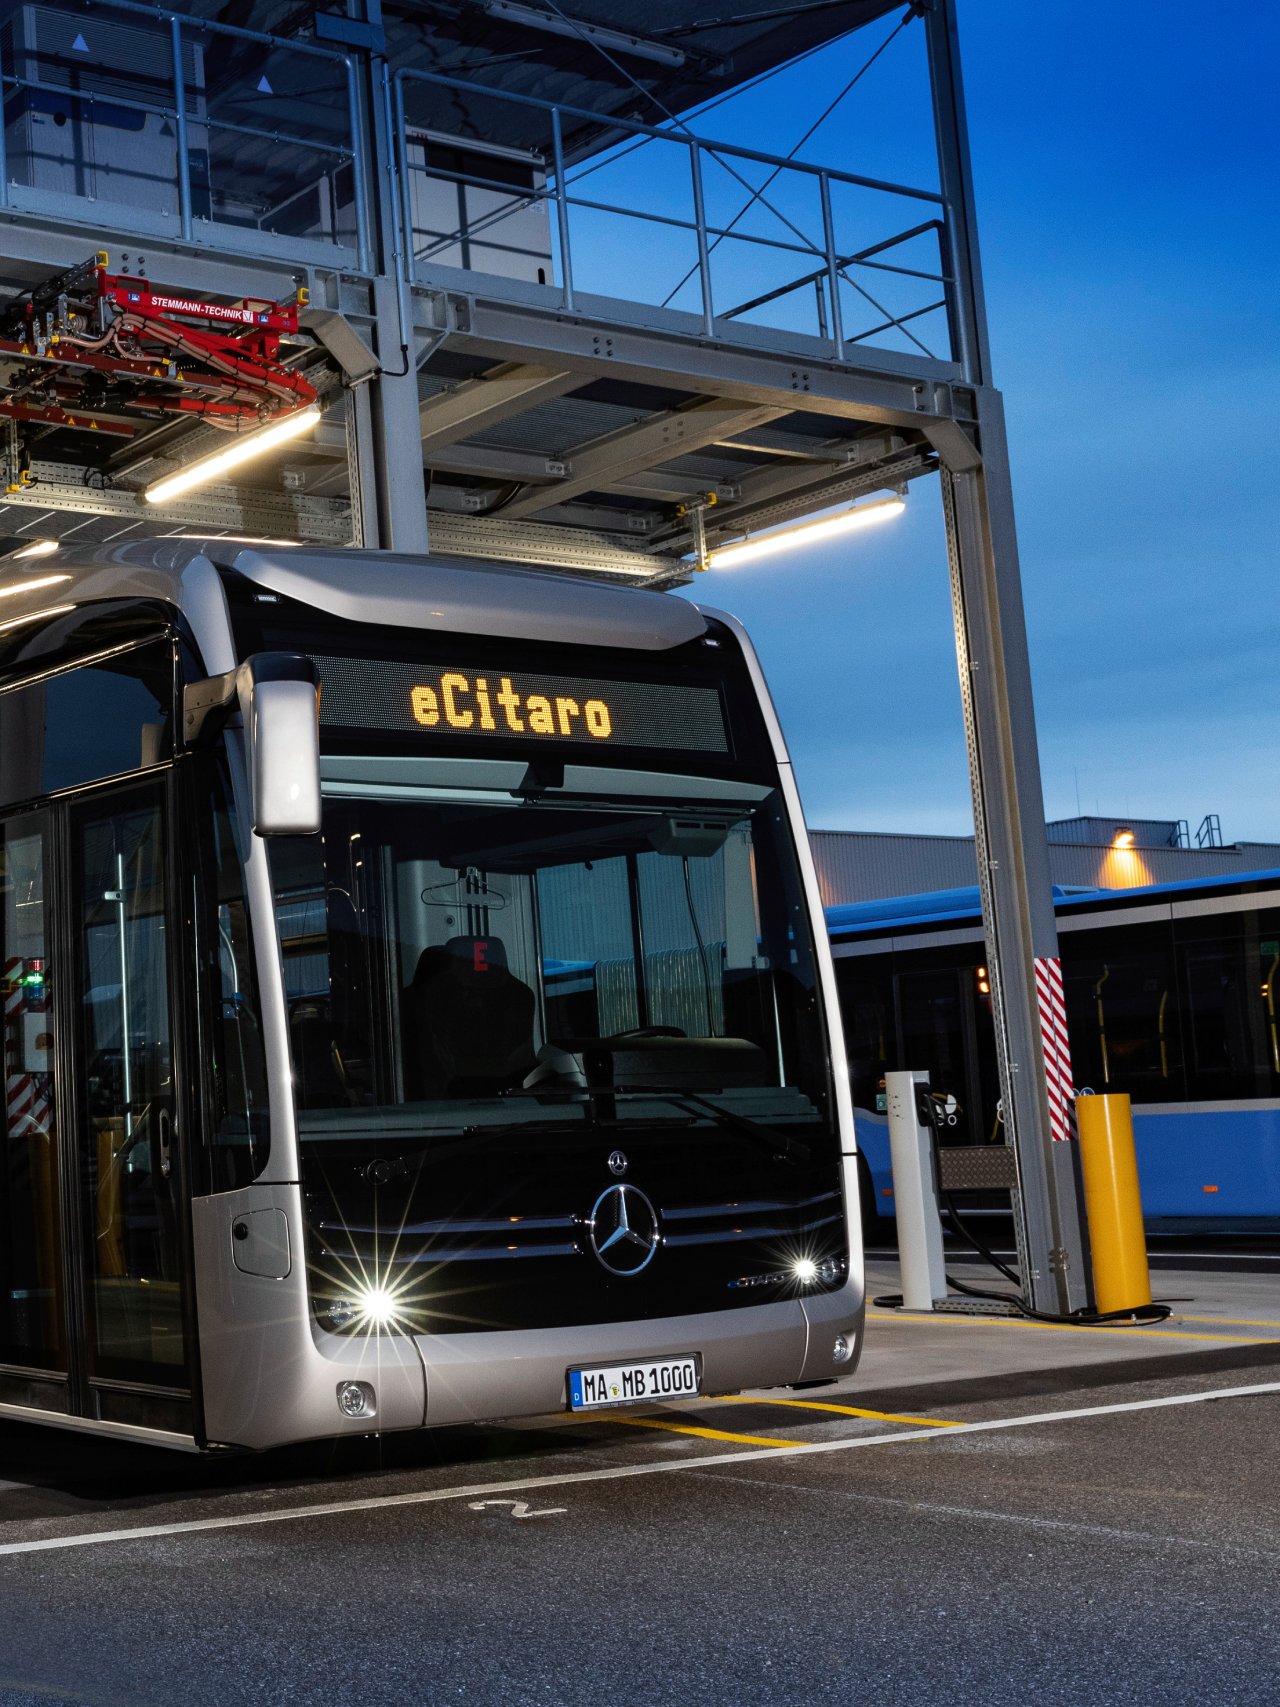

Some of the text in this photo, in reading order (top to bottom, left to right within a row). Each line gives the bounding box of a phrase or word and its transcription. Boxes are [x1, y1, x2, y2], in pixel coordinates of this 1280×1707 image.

[151, 296, 242, 319] STEMMANN-TECHNIK
[411, 673, 612, 738] eCitaro
[574, 1392, 580, 1401] D
[584, 1374, 608, 1402] MA
[622, 1370, 646, 1397] MB
[649, 1364, 694, 1394] 1000
